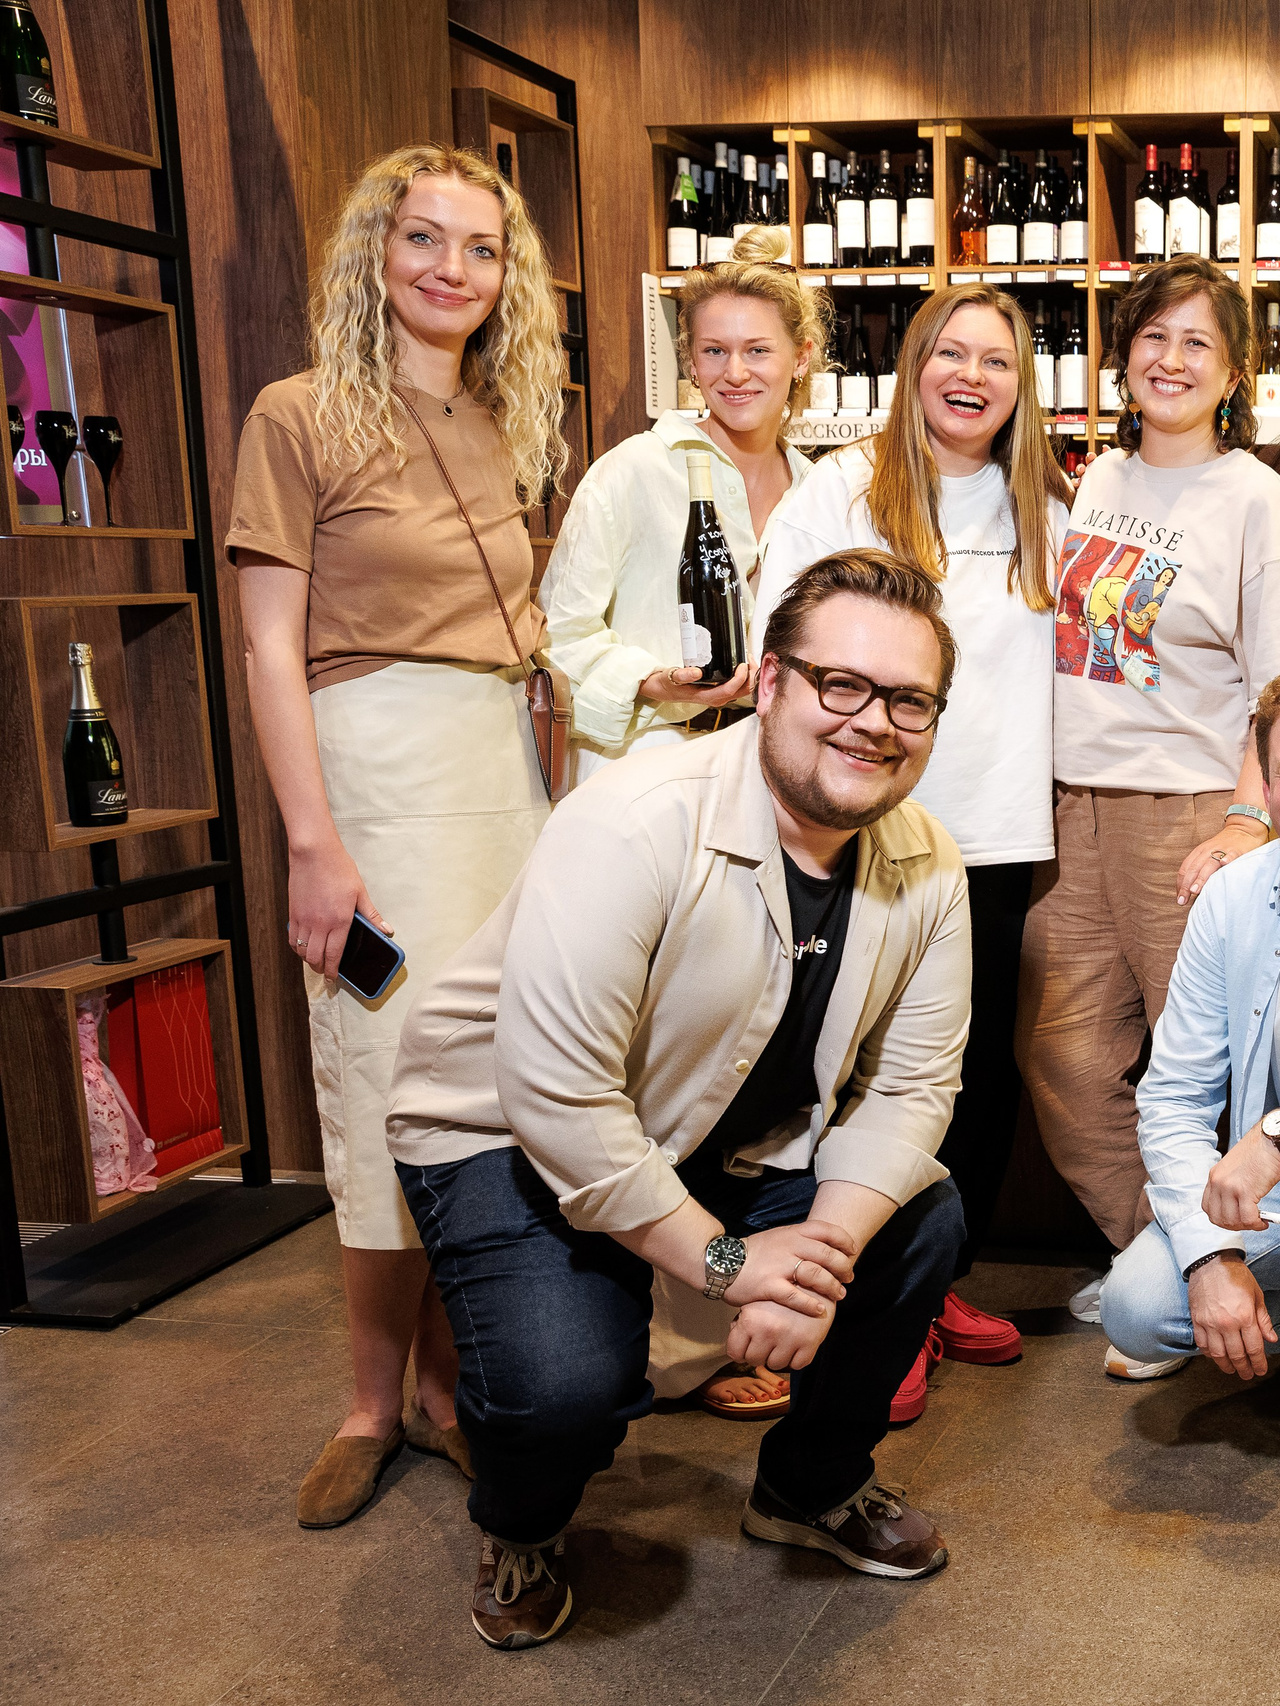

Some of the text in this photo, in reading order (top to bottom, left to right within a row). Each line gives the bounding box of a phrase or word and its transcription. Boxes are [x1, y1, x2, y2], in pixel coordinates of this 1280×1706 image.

[648, 286, 659, 408] ВИНО РОССИИ
[17, 448, 47, 472] ры
[1082, 508, 1184, 552] MATISSÉ
